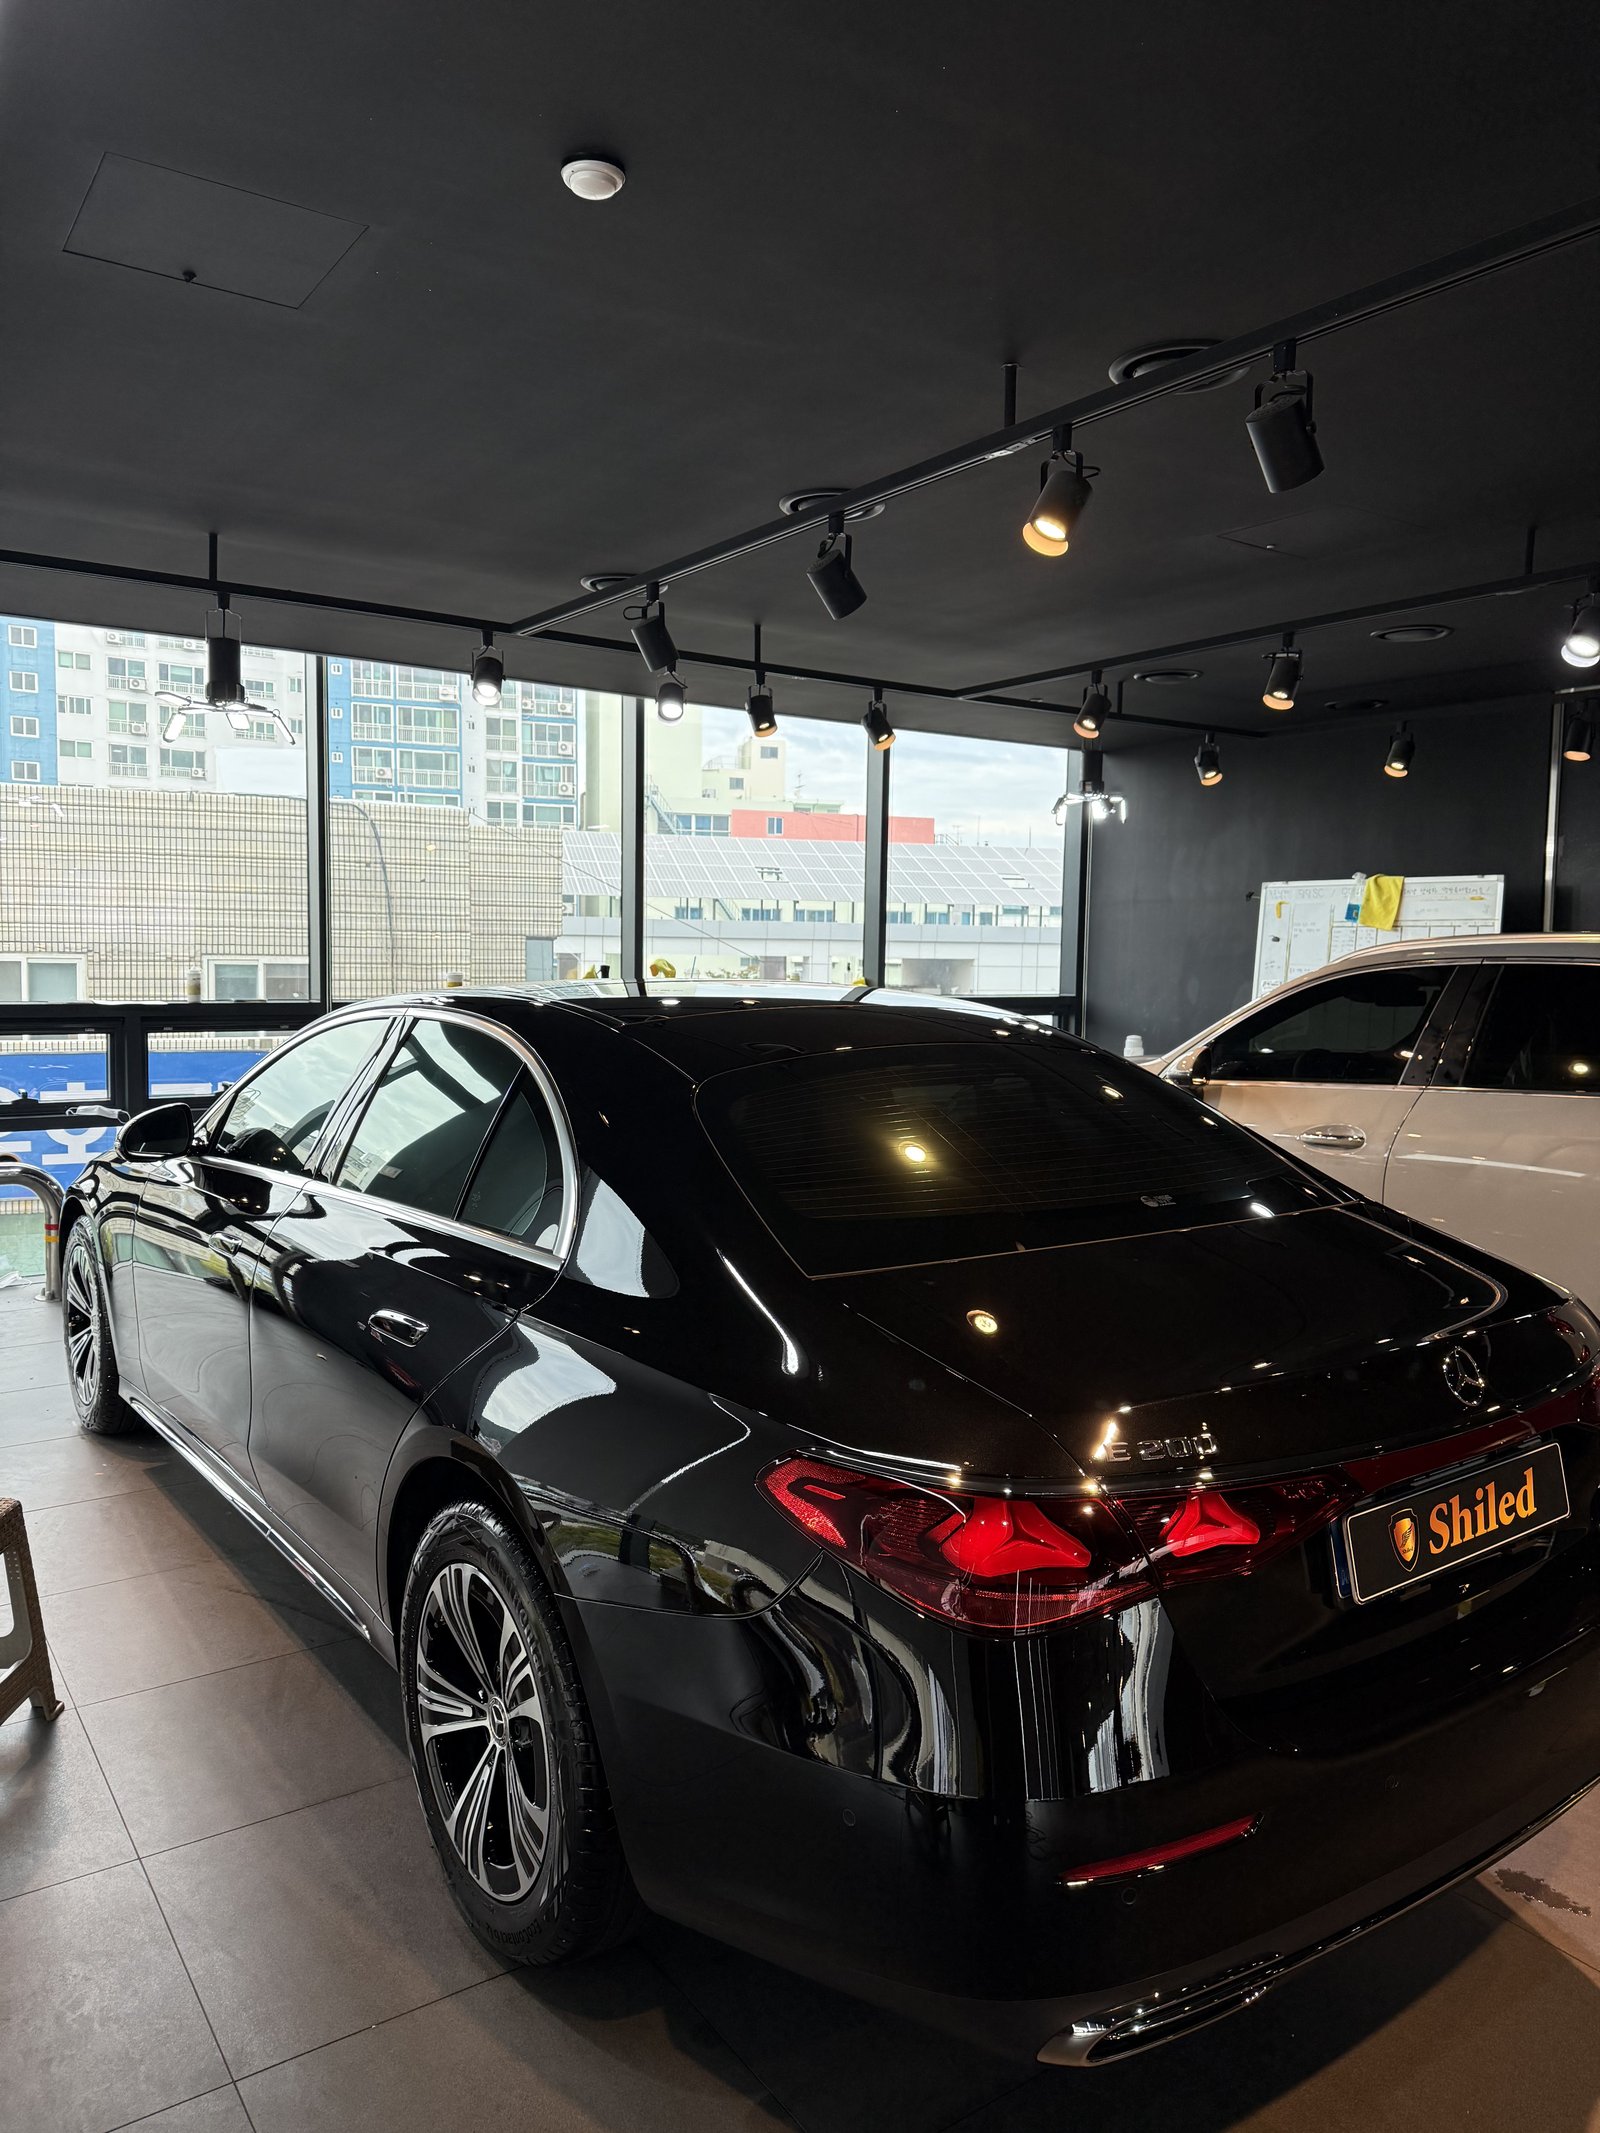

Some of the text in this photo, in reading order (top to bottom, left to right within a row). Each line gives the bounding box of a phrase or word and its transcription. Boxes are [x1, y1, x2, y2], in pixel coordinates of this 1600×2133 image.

[1103, 1433, 1218, 1463] E 200
[1428, 1466, 1538, 1555] Shiled
